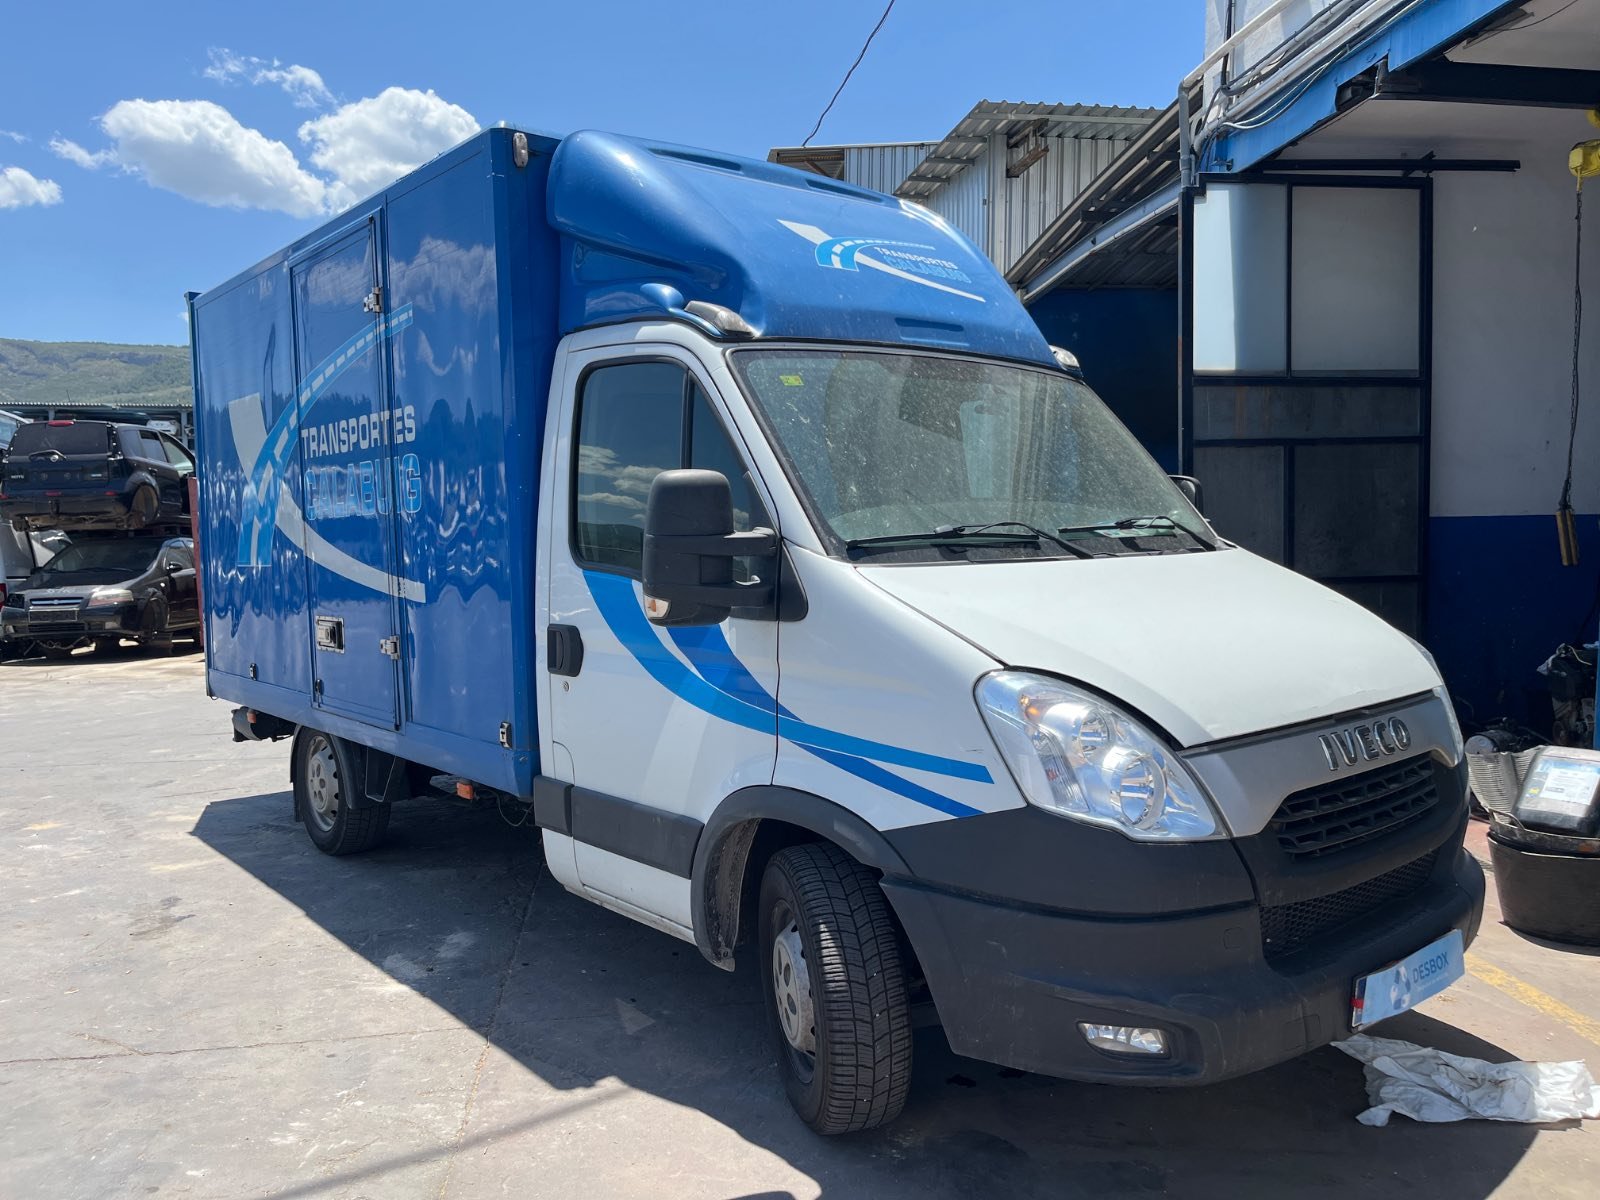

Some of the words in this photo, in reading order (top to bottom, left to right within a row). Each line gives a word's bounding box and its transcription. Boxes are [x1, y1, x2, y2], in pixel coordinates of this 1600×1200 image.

[873, 246, 958, 269] TRANSPORTES
[301, 405, 416, 459] TRANSPORTES
[1319, 716, 1411, 771] IVECO
[1412, 951, 1449, 984] DESBOX
